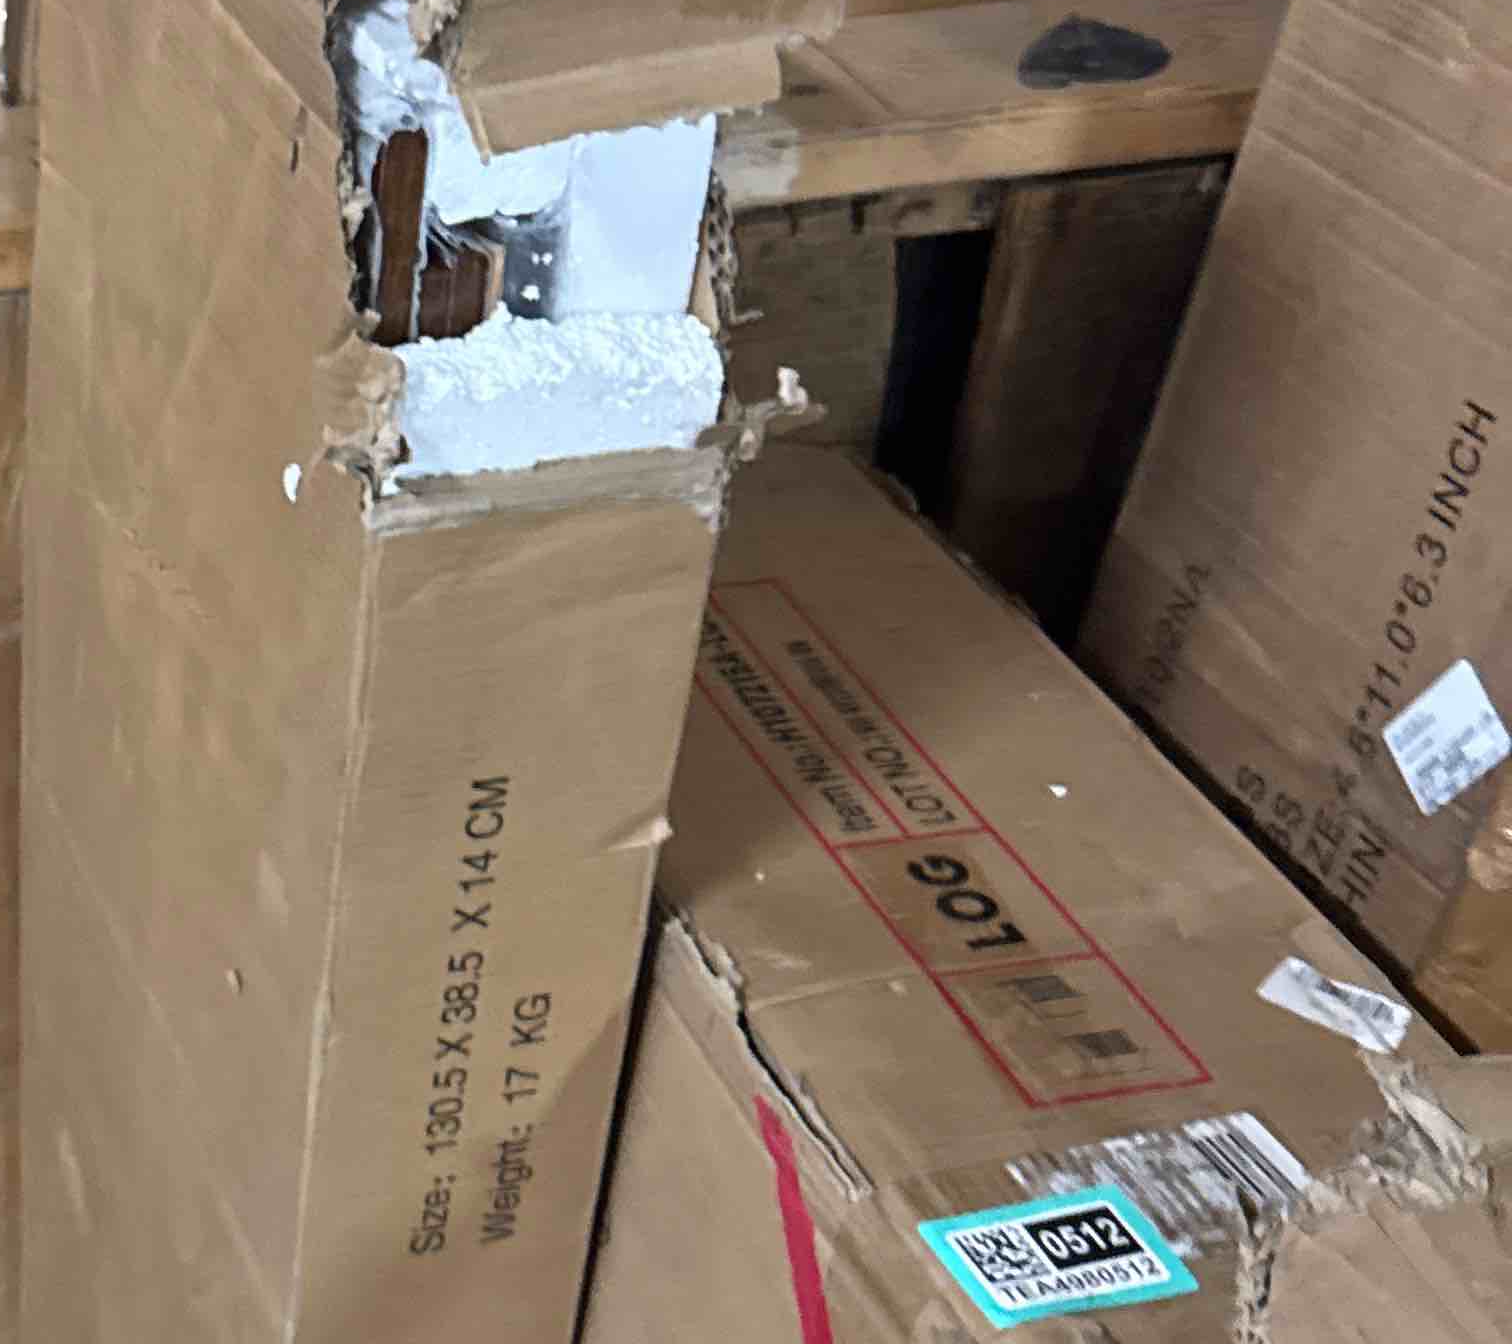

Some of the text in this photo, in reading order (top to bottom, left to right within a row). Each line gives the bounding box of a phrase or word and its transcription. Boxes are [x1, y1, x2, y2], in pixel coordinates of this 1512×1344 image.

[1428, 398, 1497, 531] INCH
[907, 855, 1028, 953] LOG
[410, 775, 509, 1256] Size: 130.5 X 38.5 X 14 CM
[480, 992, 552, 1244] Weight: 17 KG
[1039, 1216, 1130, 1260] 0512
